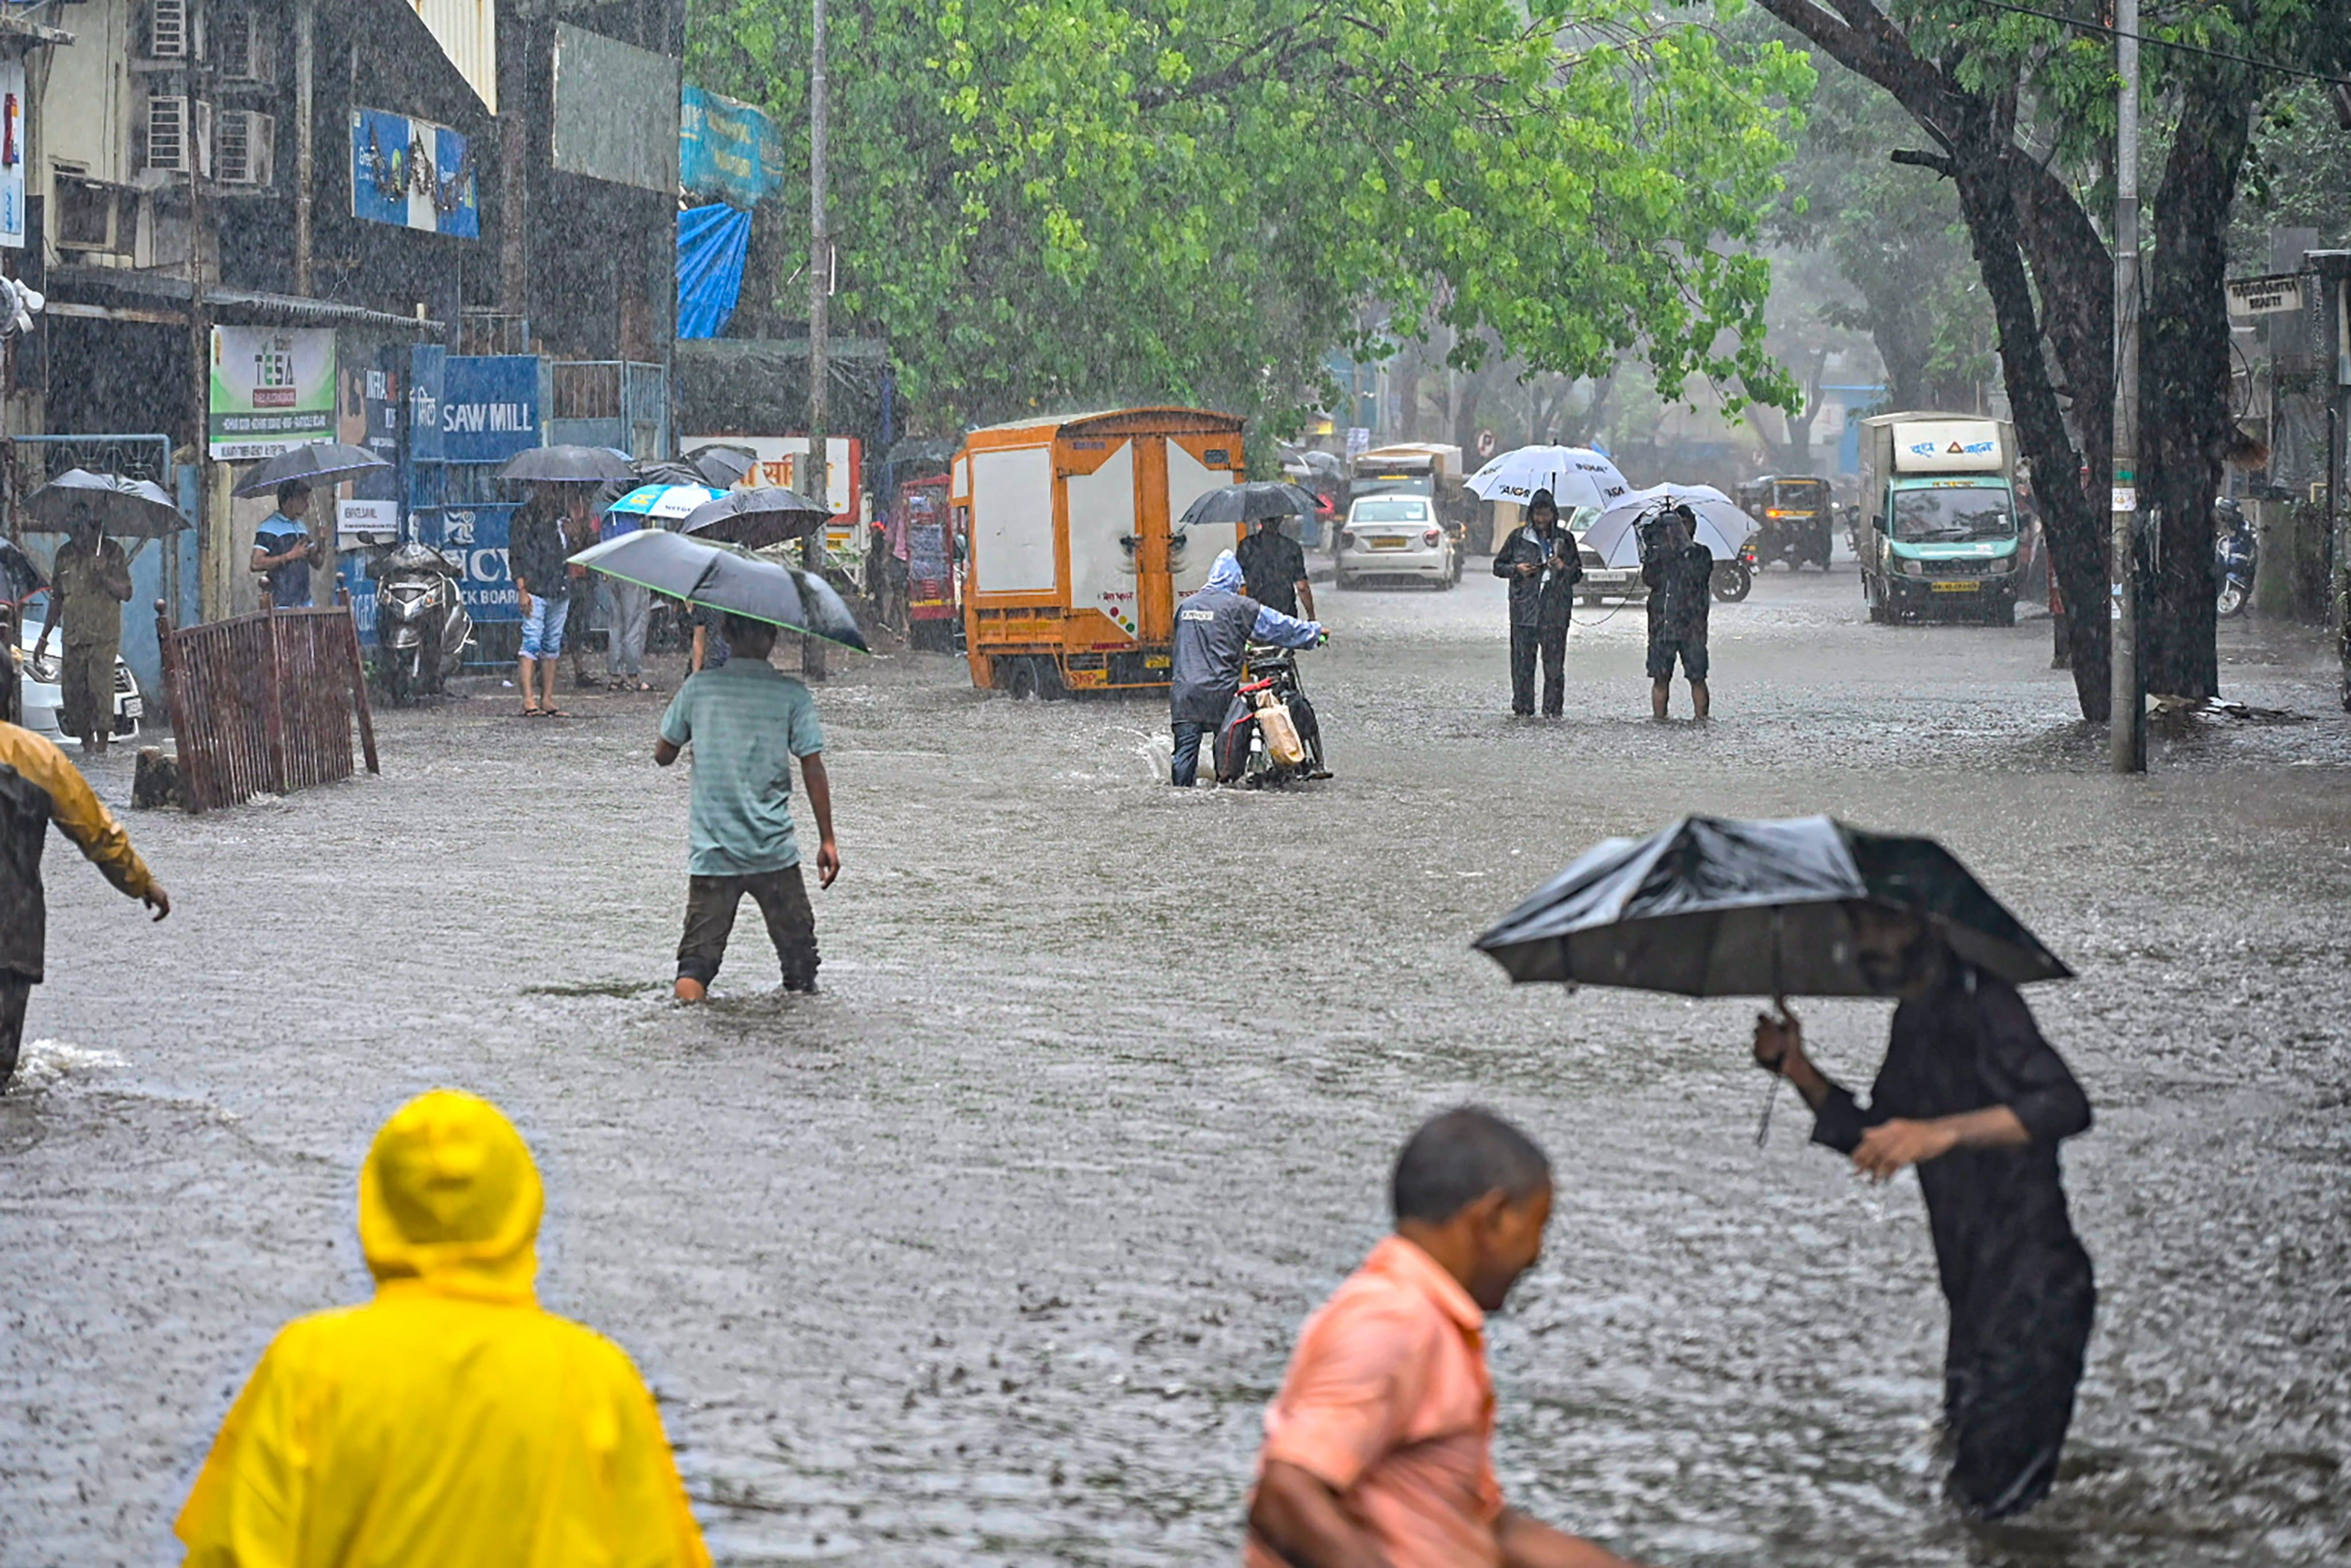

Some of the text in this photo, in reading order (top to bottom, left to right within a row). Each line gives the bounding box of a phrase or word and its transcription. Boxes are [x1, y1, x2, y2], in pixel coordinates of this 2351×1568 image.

[254, 355, 294, 386] TESA
[443, 403, 533, 432] SAW MILL
